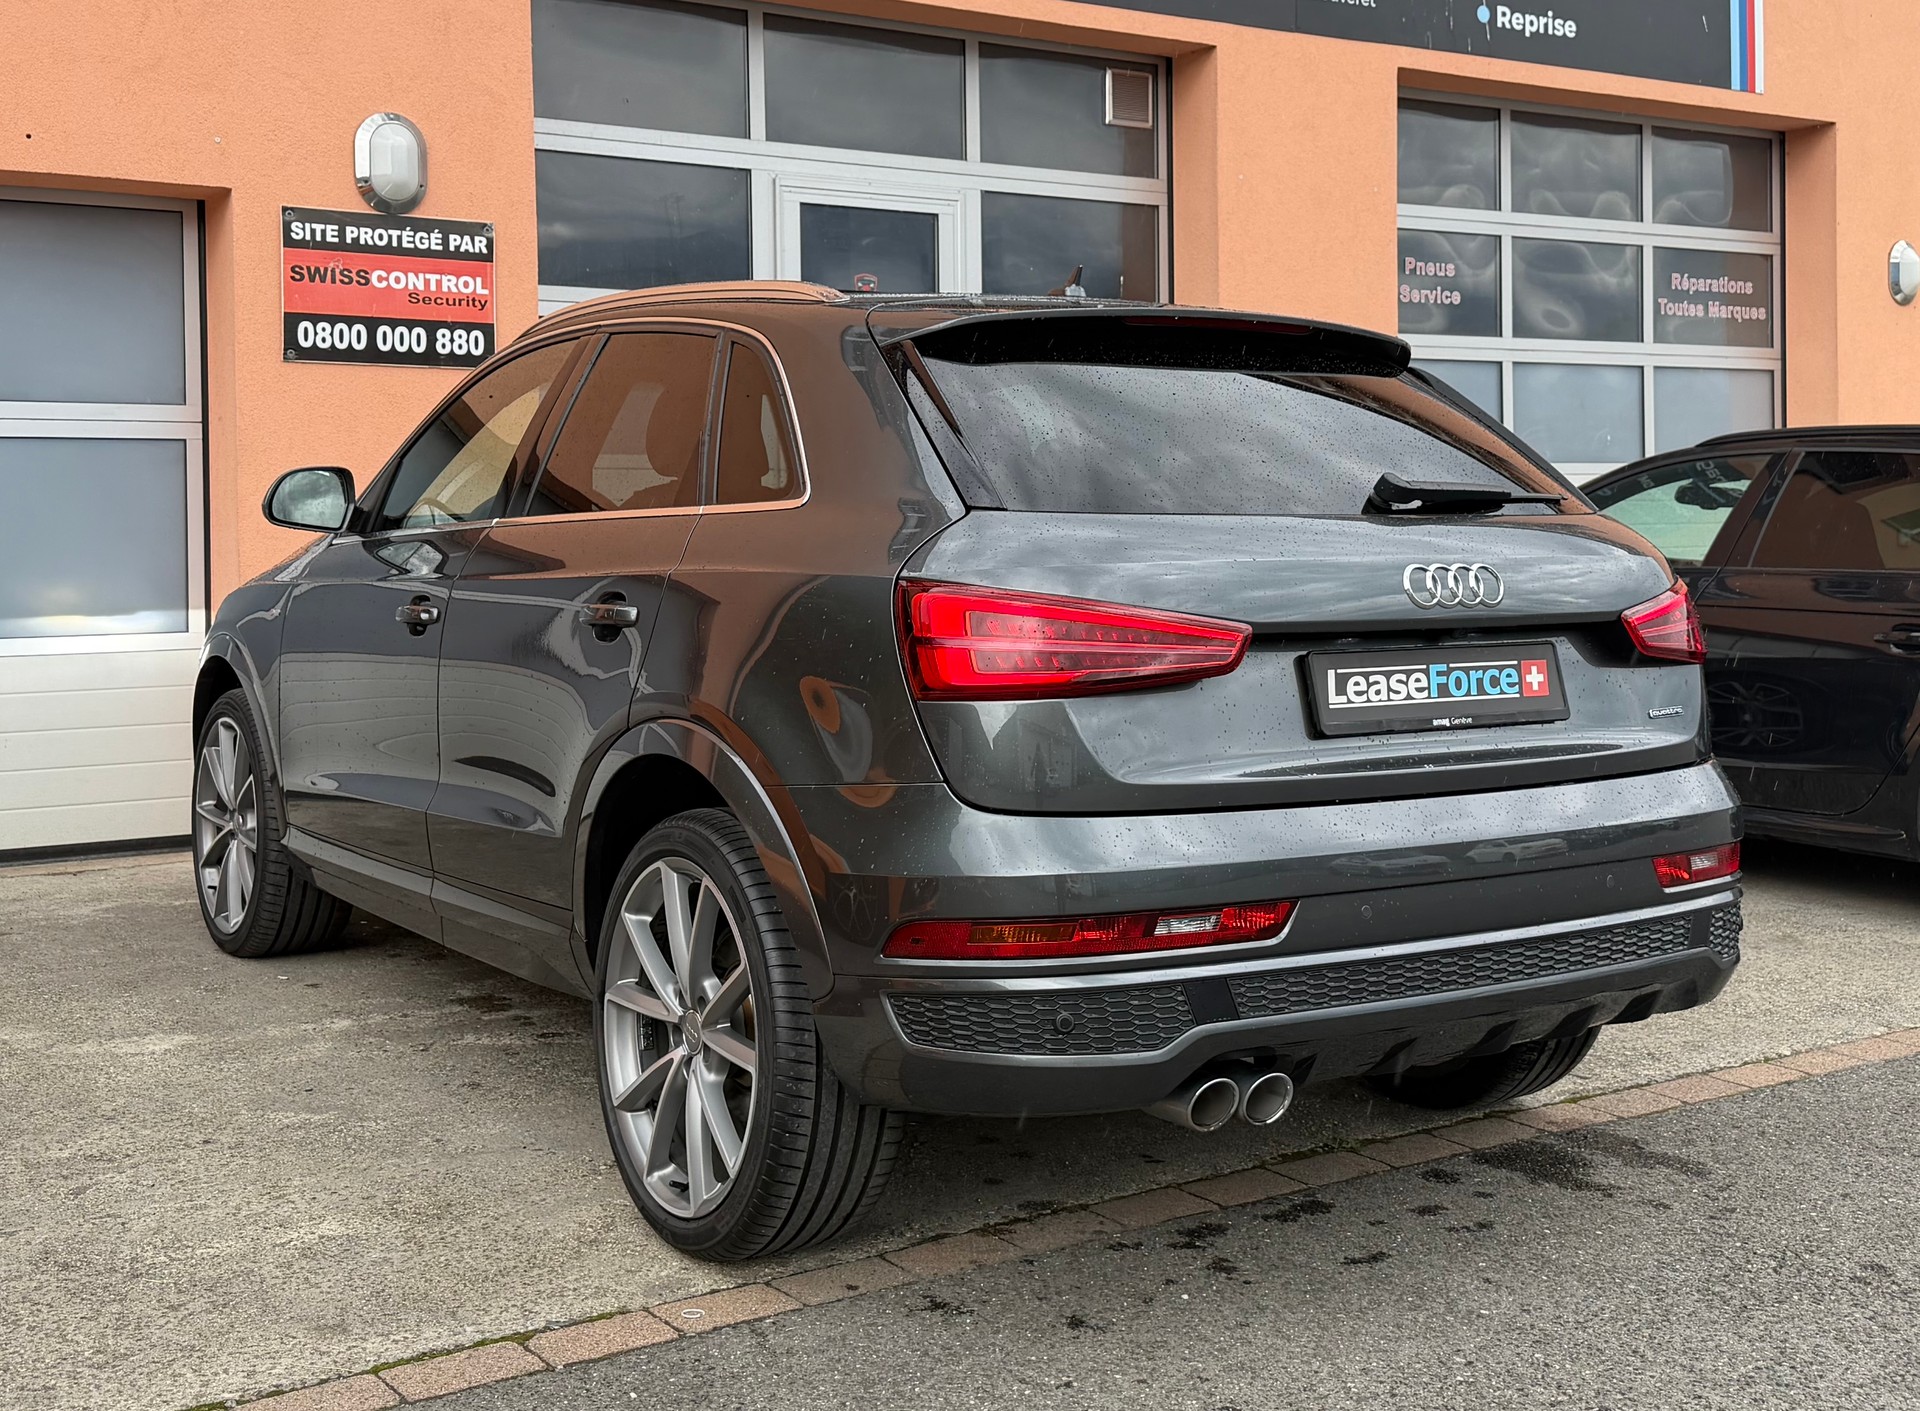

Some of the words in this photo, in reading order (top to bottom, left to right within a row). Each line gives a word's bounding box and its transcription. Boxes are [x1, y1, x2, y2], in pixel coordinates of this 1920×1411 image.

[1496, 5, 1577, 38] Reprise
[290, 221, 340, 243] SITE
[345, 226, 444, 251] PROTÉGÉ
[448, 234, 488, 254] PAR
[1405, 256, 1456, 277] Pneus
[1399, 284, 1462, 305] Service
[1671, 272, 1754, 295] Réparations
[407, 292, 489, 311] Security
[1657, 298, 1704, 317] Toutes
[1708, 301, 1767, 323] Marques
[297, 320, 368, 351] 0800
[375, 325, 428, 354] 000
[435, 328, 485, 356] 880
[1327, 663, 1520, 704] LeaseForce
